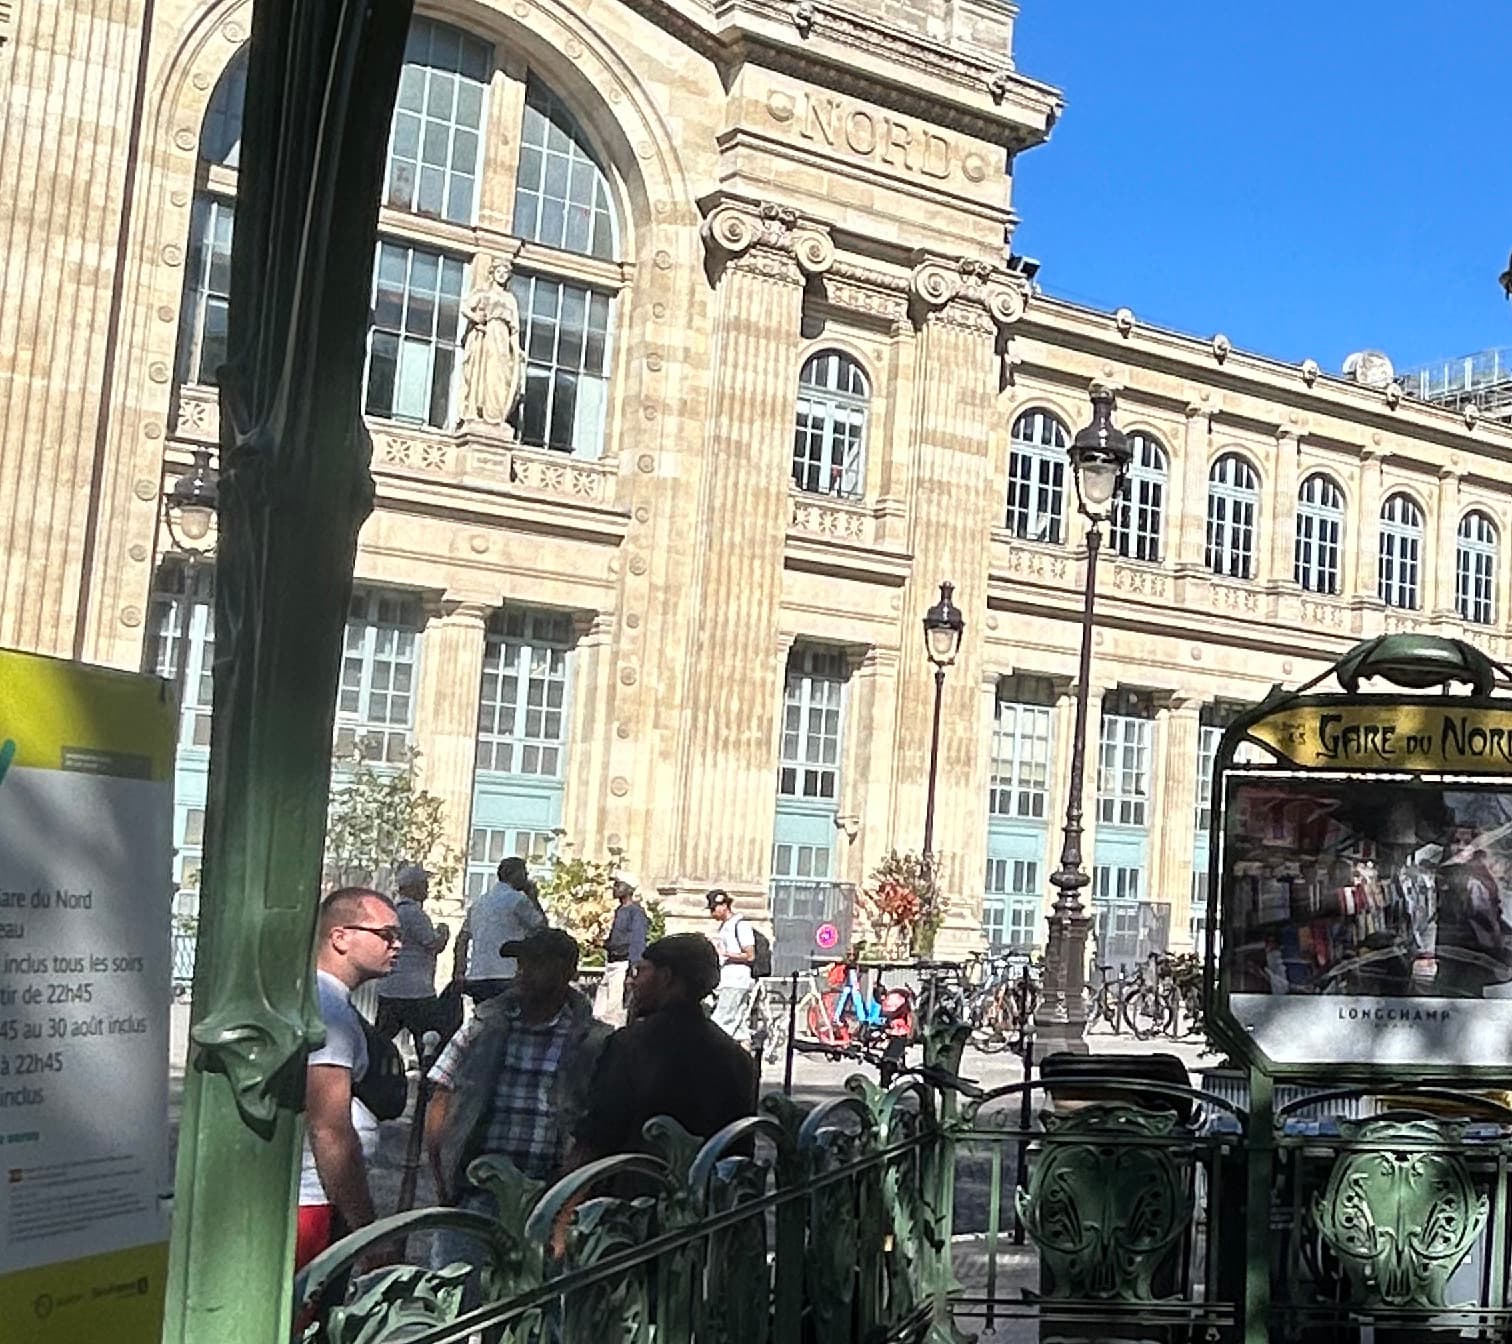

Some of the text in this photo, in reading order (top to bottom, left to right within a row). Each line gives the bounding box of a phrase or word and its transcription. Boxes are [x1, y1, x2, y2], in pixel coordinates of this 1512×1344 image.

[800, 92, 952, 180] NORD
[1316, 712, 1397, 762] GARE
[0, 887, 93, 910] are du Nord
[4, 953, 144, 974] inclus tous les soirs
[22, 983, 43, 1005] de
[46, 982, 93, 1004] 22h45
[1338, 1007, 1451, 1023] LONGCHAMP
[24, 1022, 42, 1040] au
[48, 1017, 67, 1039] 30
[71, 1016, 104, 1038] août
[108, 1014, 148, 1035] inclus
[16, 1051, 63, 1075] 22h45
